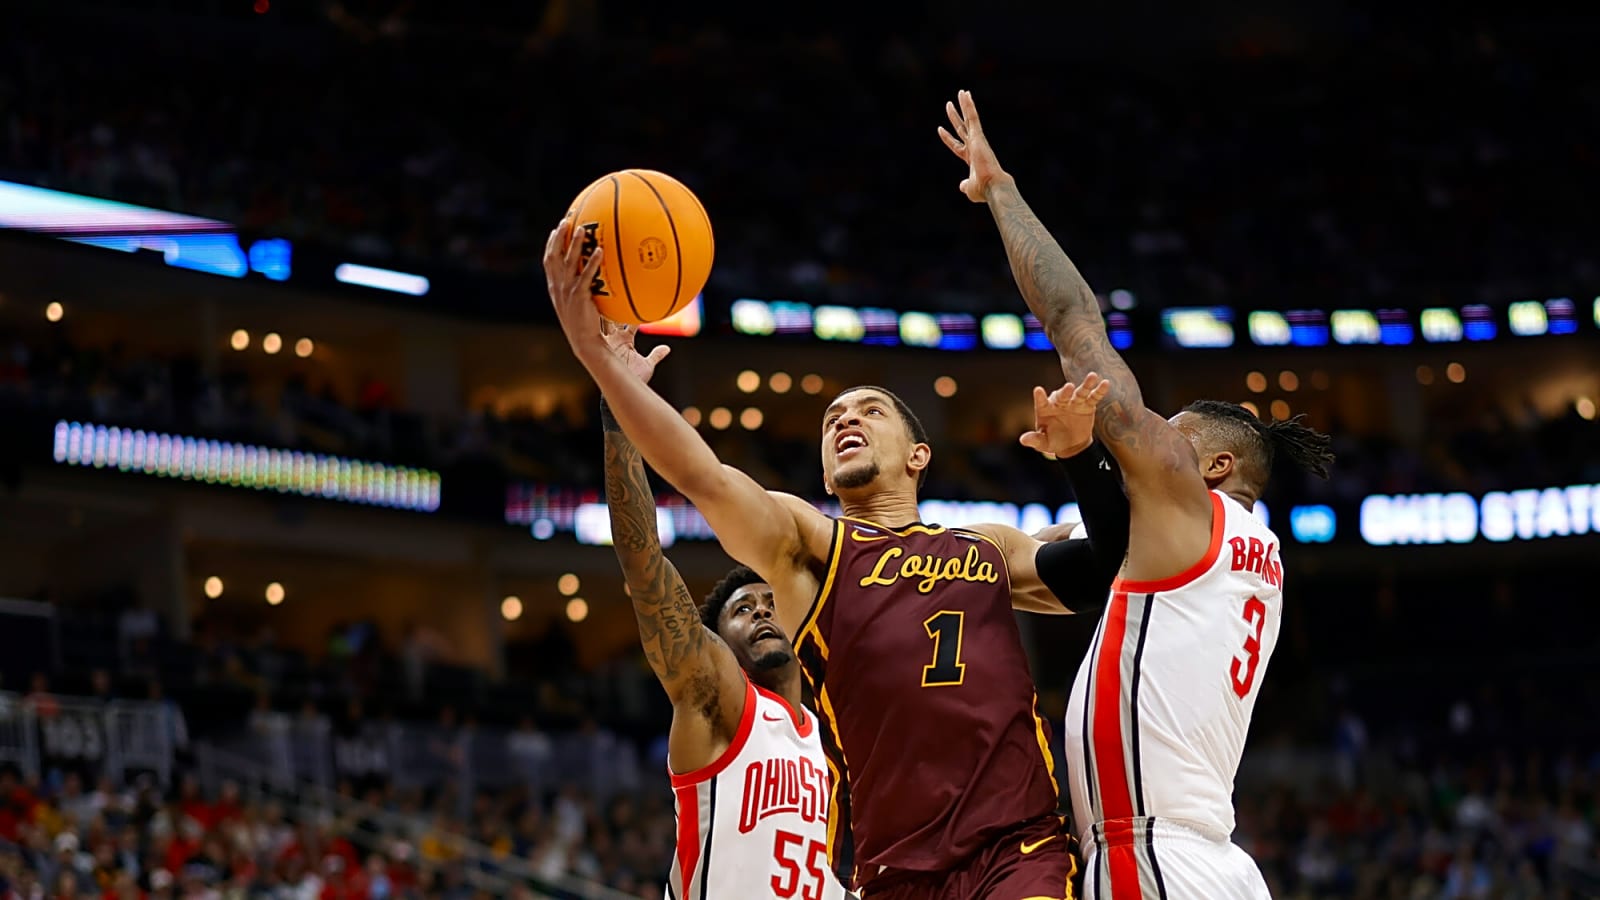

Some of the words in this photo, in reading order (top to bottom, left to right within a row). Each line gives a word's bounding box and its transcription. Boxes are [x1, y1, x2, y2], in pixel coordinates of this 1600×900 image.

[859, 545, 999, 593] Loyola
[659, 606, 684, 641] LION
[921, 610, 966, 688] 1
[1229, 595, 1266, 701] 3
[799, 755, 830, 824] ST
[770, 829, 828, 900] 55
